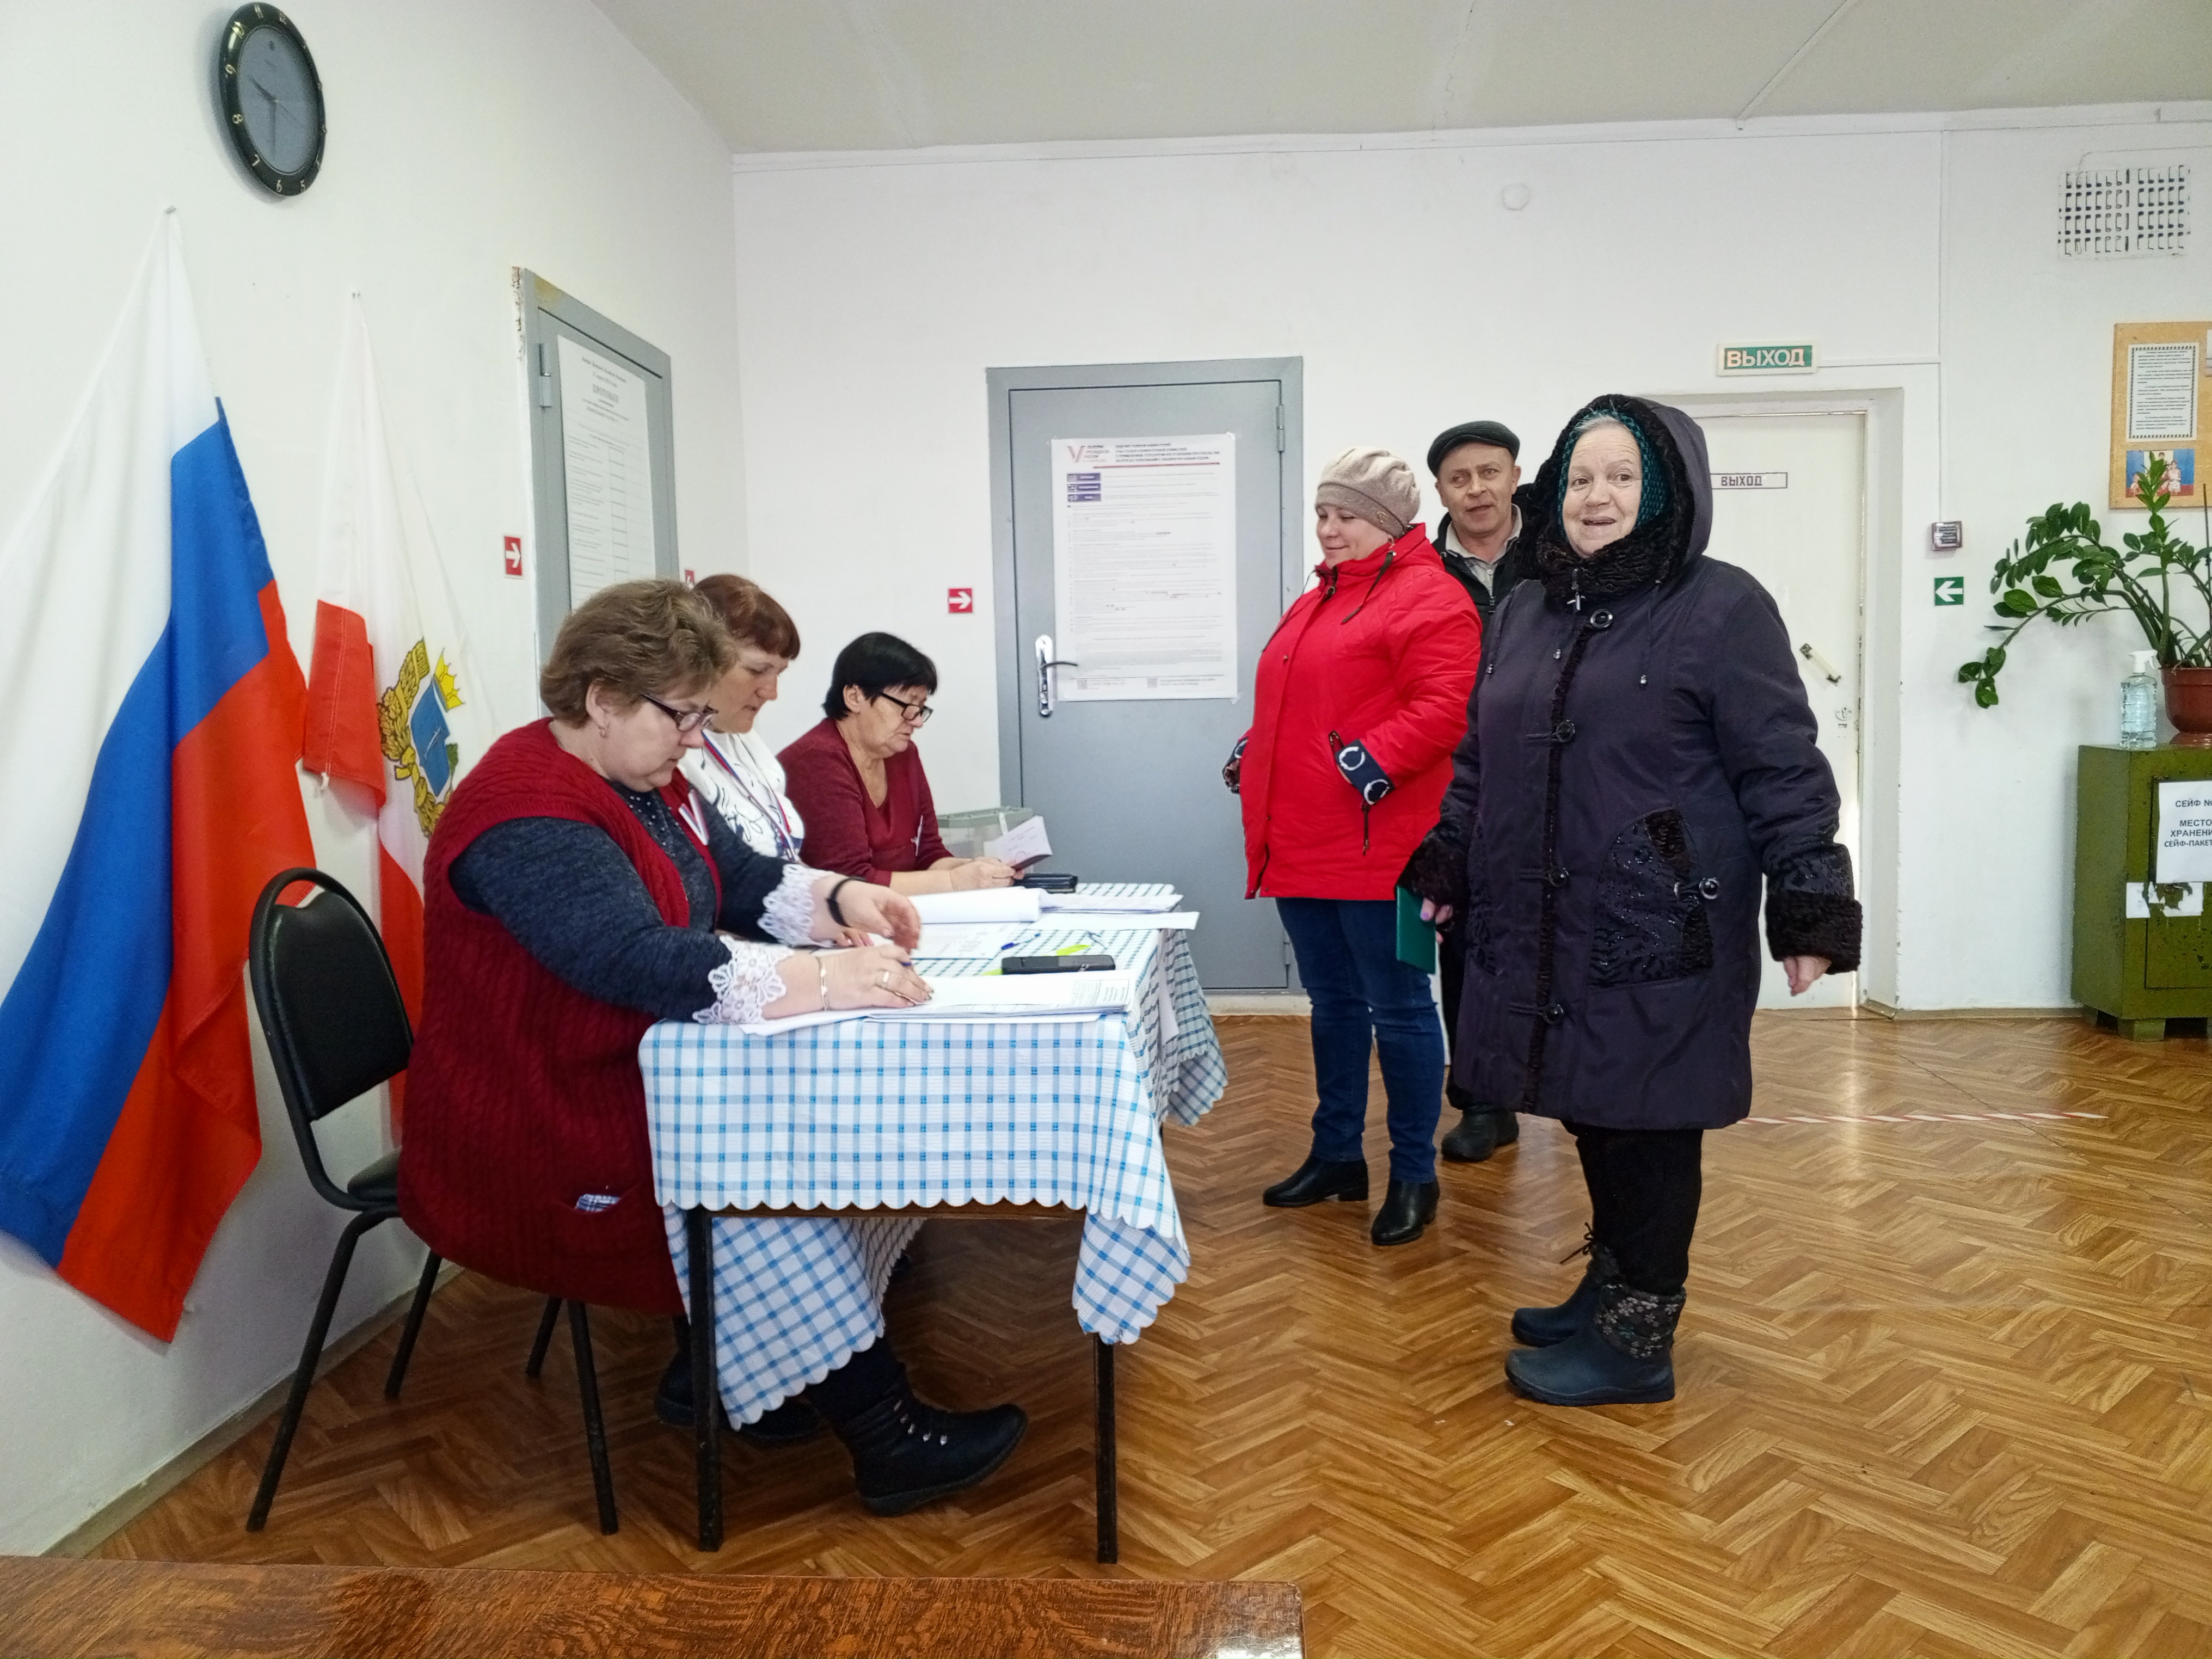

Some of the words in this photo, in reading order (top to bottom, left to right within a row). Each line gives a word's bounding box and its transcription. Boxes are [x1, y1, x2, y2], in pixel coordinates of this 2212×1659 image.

[232, 114, 243, 124] 8
[252, 154, 261, 166] 7
[276, 180, 282, 192] 6
[300, 180, 306, 192] 5
[1726, 348, 1805, 367] ВЫХОД
[1721, 475, 1763, 487] ВЫХОД
[2175, 798, 2201, 808] СЕЙФ
